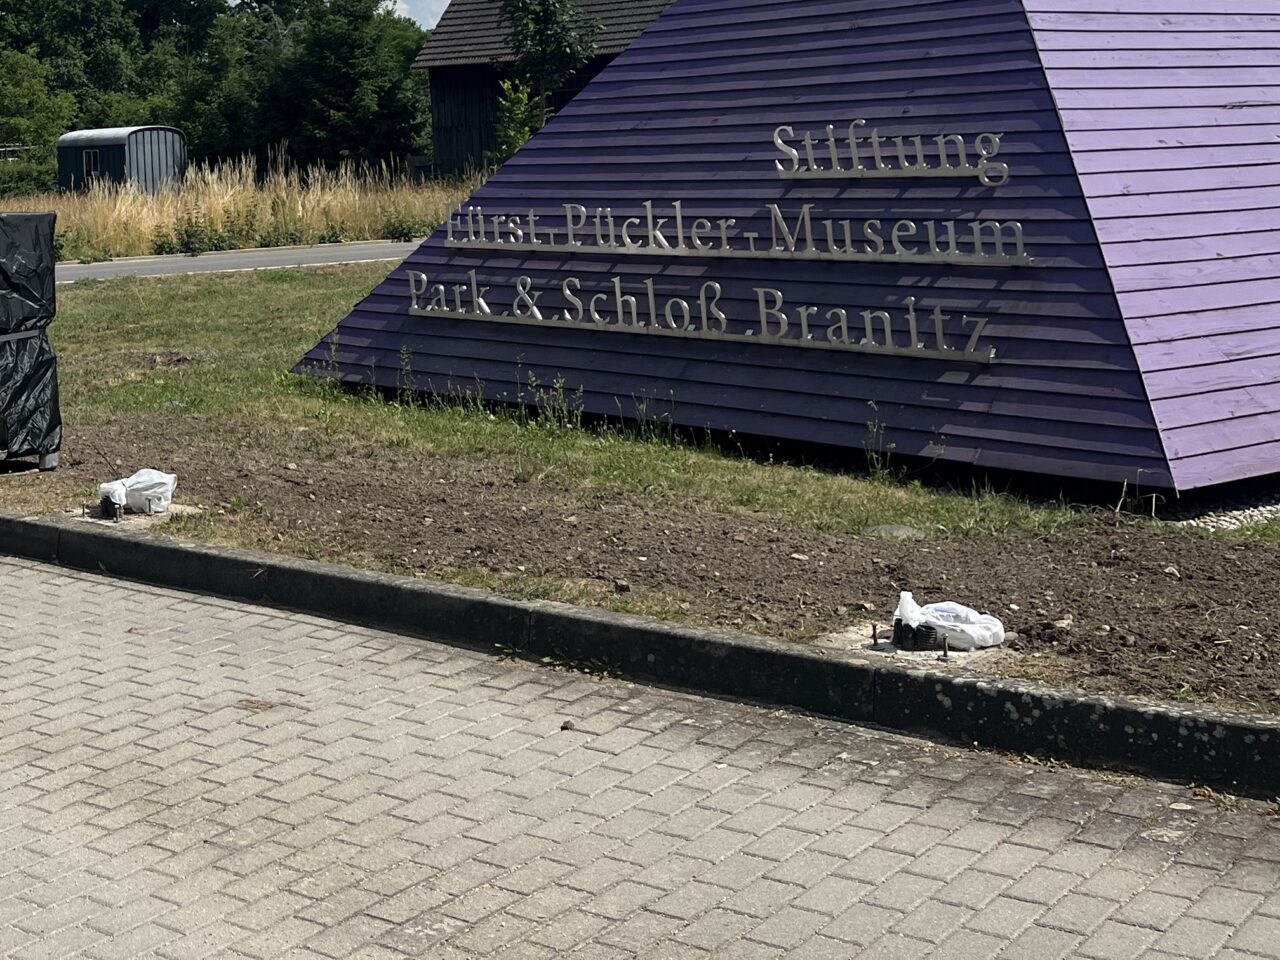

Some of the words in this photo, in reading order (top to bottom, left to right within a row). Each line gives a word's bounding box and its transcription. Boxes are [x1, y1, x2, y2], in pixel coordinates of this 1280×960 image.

[773, 119, 1009, 186] Stiftung
[446, 200, 1026, 259] Fürst-Pückler-Museum
[406, 270, 492, 316] Park
[513, 276, 544, 320] &
[562, 276, 728, 333] Schloß
[753, 287, 990, 354] Branitz
